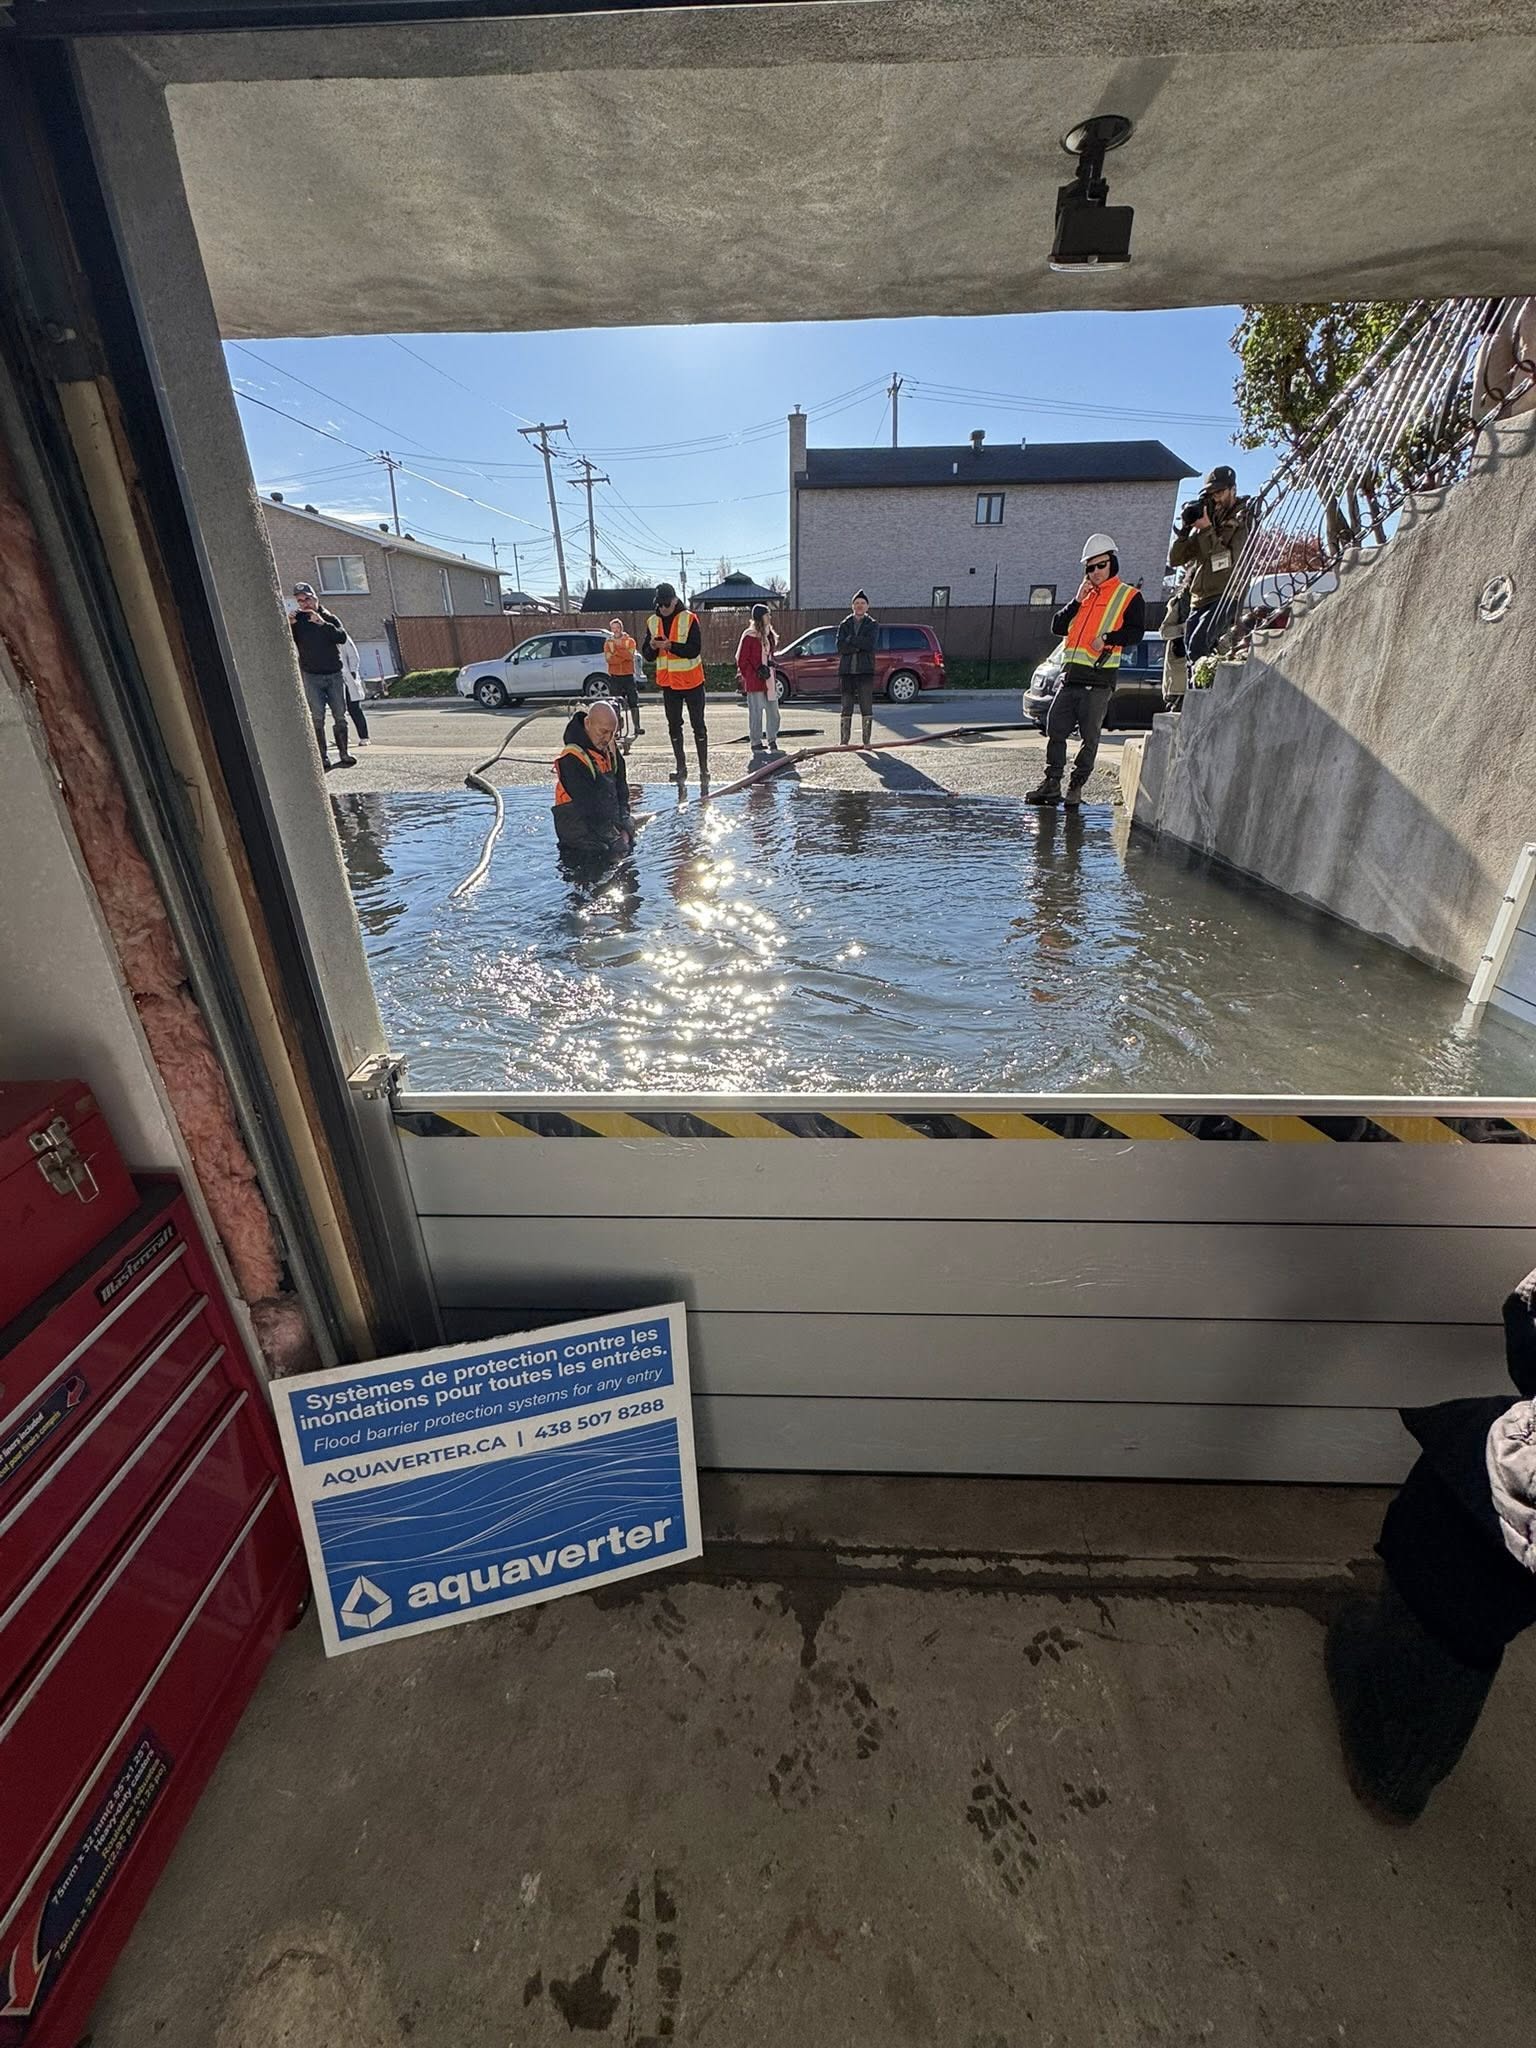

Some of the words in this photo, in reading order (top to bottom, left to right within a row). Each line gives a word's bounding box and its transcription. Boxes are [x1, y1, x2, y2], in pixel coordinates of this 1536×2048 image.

[100, 1225, 174, 1302] Mastercraft
[300, 1394, 429, 1430] inondations
[435, 1383, 483, 1407] pour
[488, 1367, 552, 1391] toutes
[558, 1360, 586, 1377] les
[591, 1345, 667, 1369] entrées.
[306, 1378, 415, 1411] Systèmes
[421, 1371, 447, 1387] de
[454, 1349, 557, 1383] protection
[564, 1336, 625, 1358] contre
[631, 1328, 658, 1344] les
[314, 1430, 361, 1452] Flood
[366, 1420, 420, 1441] barrier
[424, 1403, 502, 1432] protection
[508, 1388, 568, 1414] systems
[572, 1383, 593, 1397] for
[596, 1377, 622, 1391] any
[626, 1368, 663, 1385] entry
[18, 1411, 45, 1440] included
[322, 1436, 507, 1487] AQUAVERTER.CA
[534, 1420, 572, 1439] 438
[578, 1410, 612, 1430] 507
[618, 1398, 665, 1420] 8288
[408, 1517, 671, 1609] aquaverter
[93, 1787, 132, 1852] Heavy-duty
